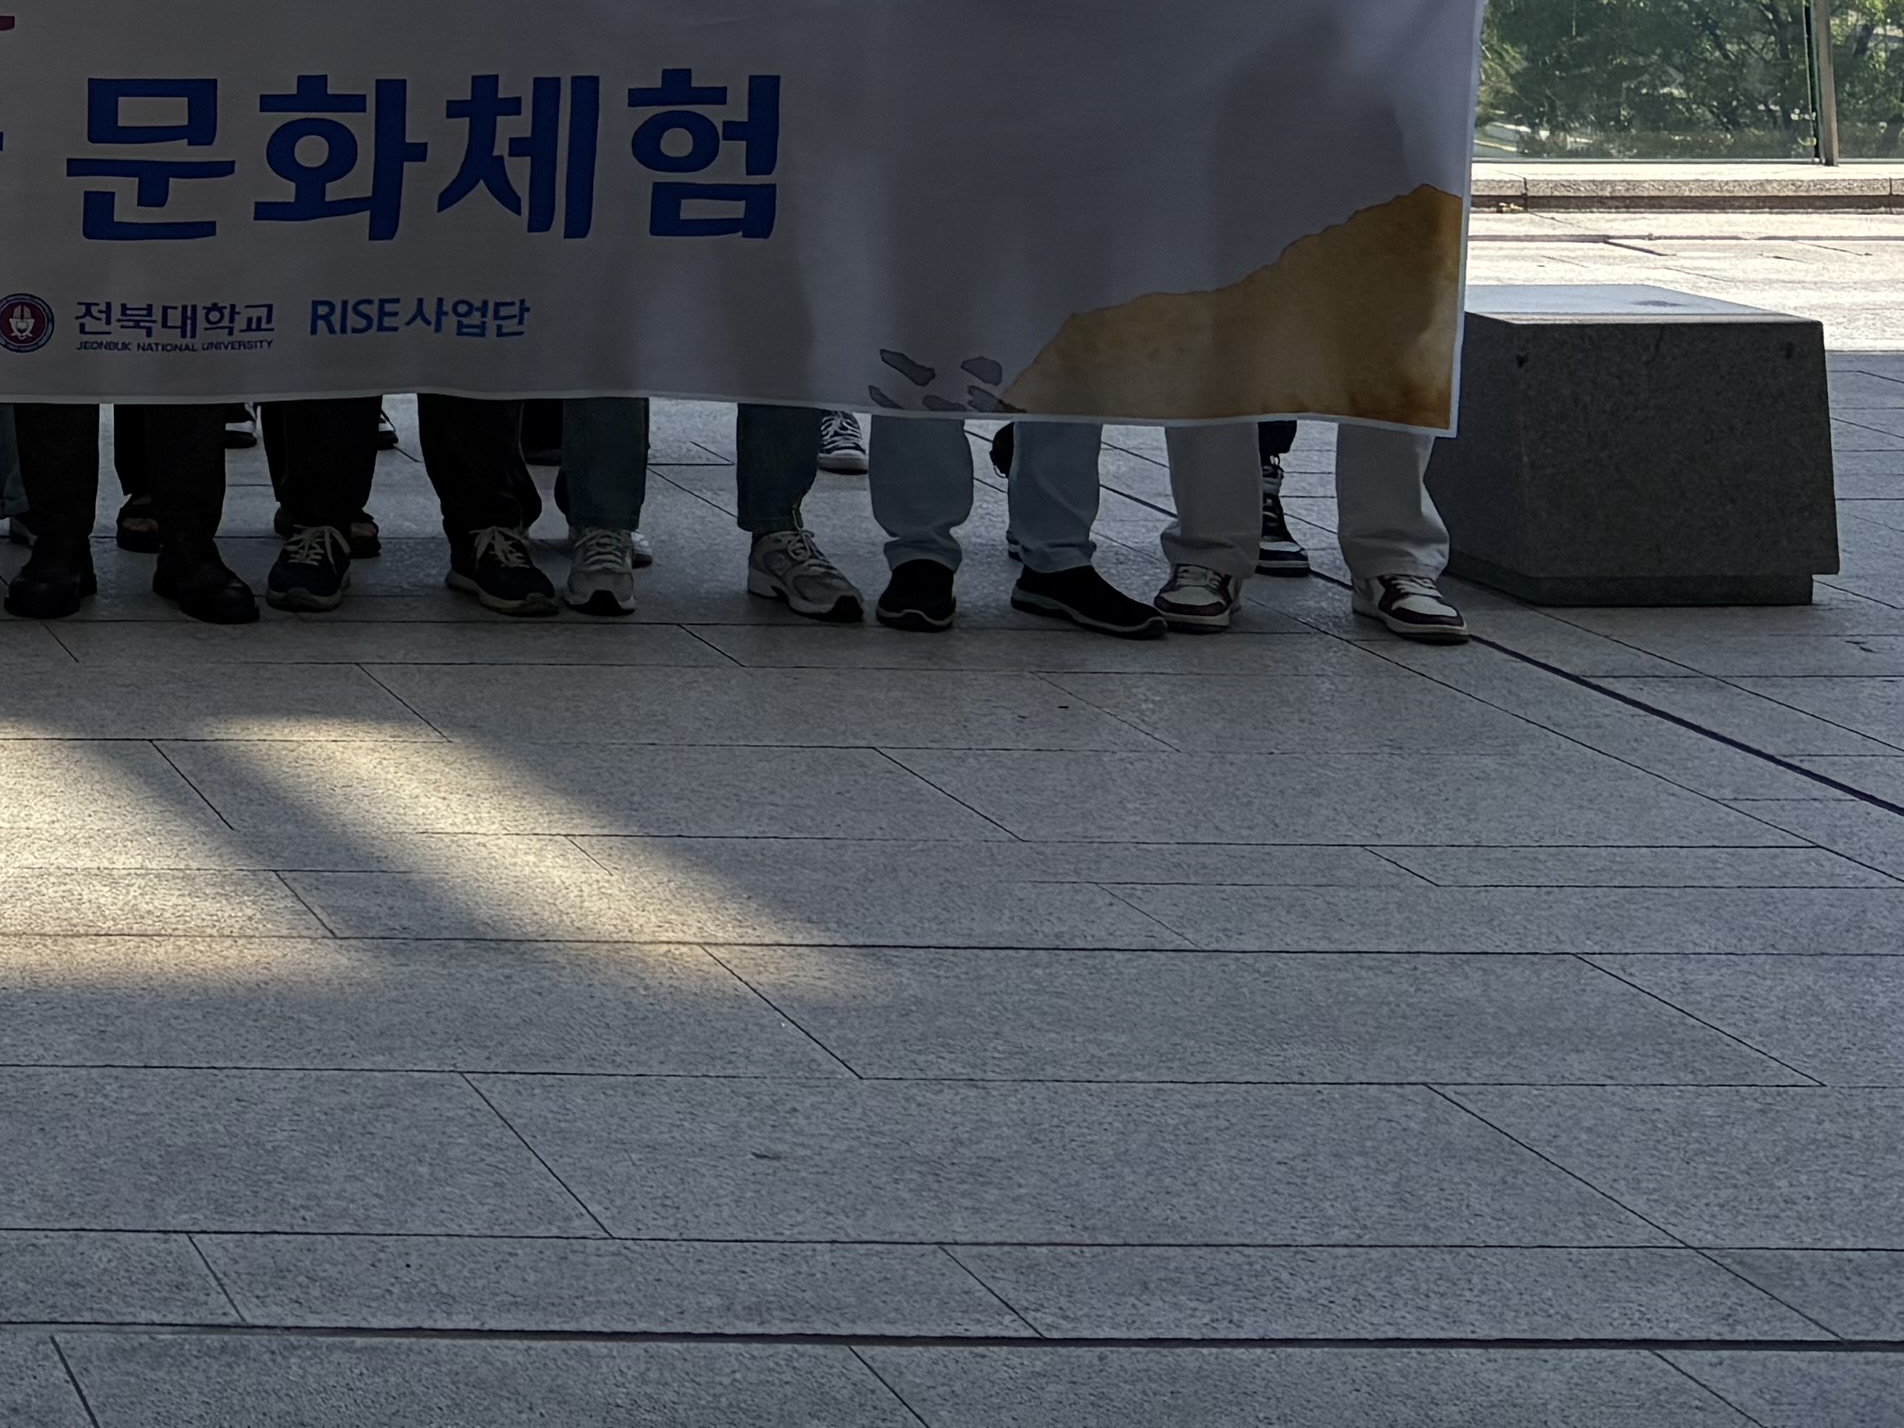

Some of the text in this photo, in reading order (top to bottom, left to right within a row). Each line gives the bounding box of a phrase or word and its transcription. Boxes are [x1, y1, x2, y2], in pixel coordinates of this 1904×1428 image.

[67, 69, 780, 242] 문화체험
[75, 302, 274, 339] 전북대학교
[76, 339, 274, 353] JEONBUK NATIONAL UNIVERSITY
